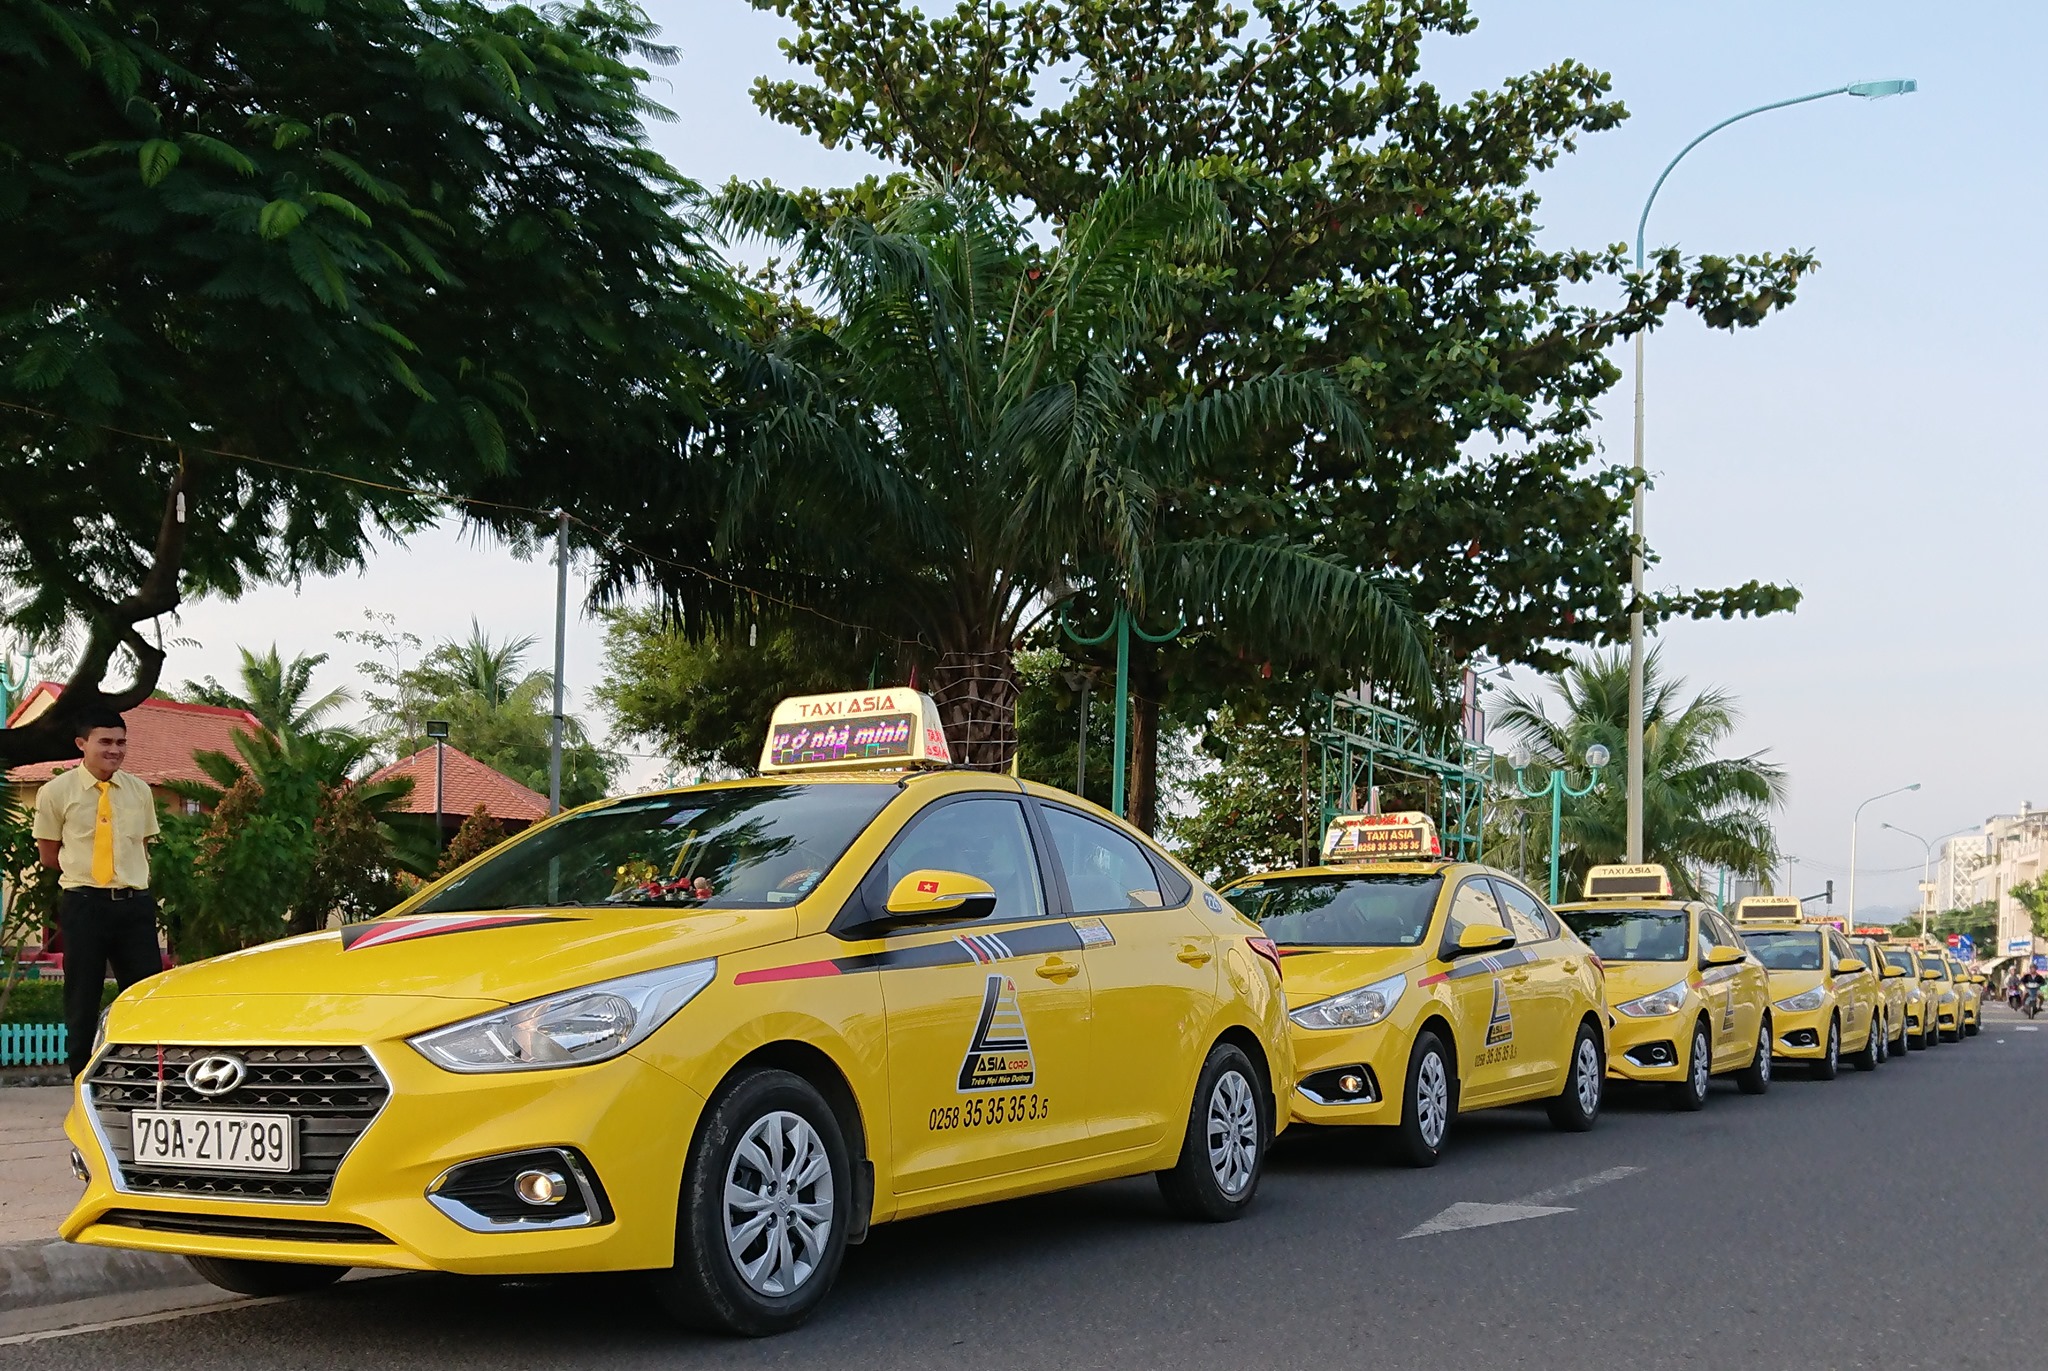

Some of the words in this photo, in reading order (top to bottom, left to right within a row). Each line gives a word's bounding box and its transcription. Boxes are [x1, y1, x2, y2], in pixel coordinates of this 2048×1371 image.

[799, 701, 842, 717] TAXI
[847, 695, 895, 713] ASIA
[1366, 830, 1389, 841] TAXI
[1390, 829, 1415, 840] ASIA
[1377, 842, 1387, 851] 35
[1388, 842, 1398, 850] 35
[1399, 841, 1409, 850] 35
[1410, 840, 1420, 849] 35
[976, 1056, 1007, 1071] ASIA
[1008, 1060, 1029, 1070] CORP
[929, 1106, 960, 1131] 0258
[963, 1099, 983, 1127] 35
[986, 1097, 1005, 1125] 35
[1008, 1095, 1026, 1122] 35
[1029, 1094, 1049, 1120] 3.5
